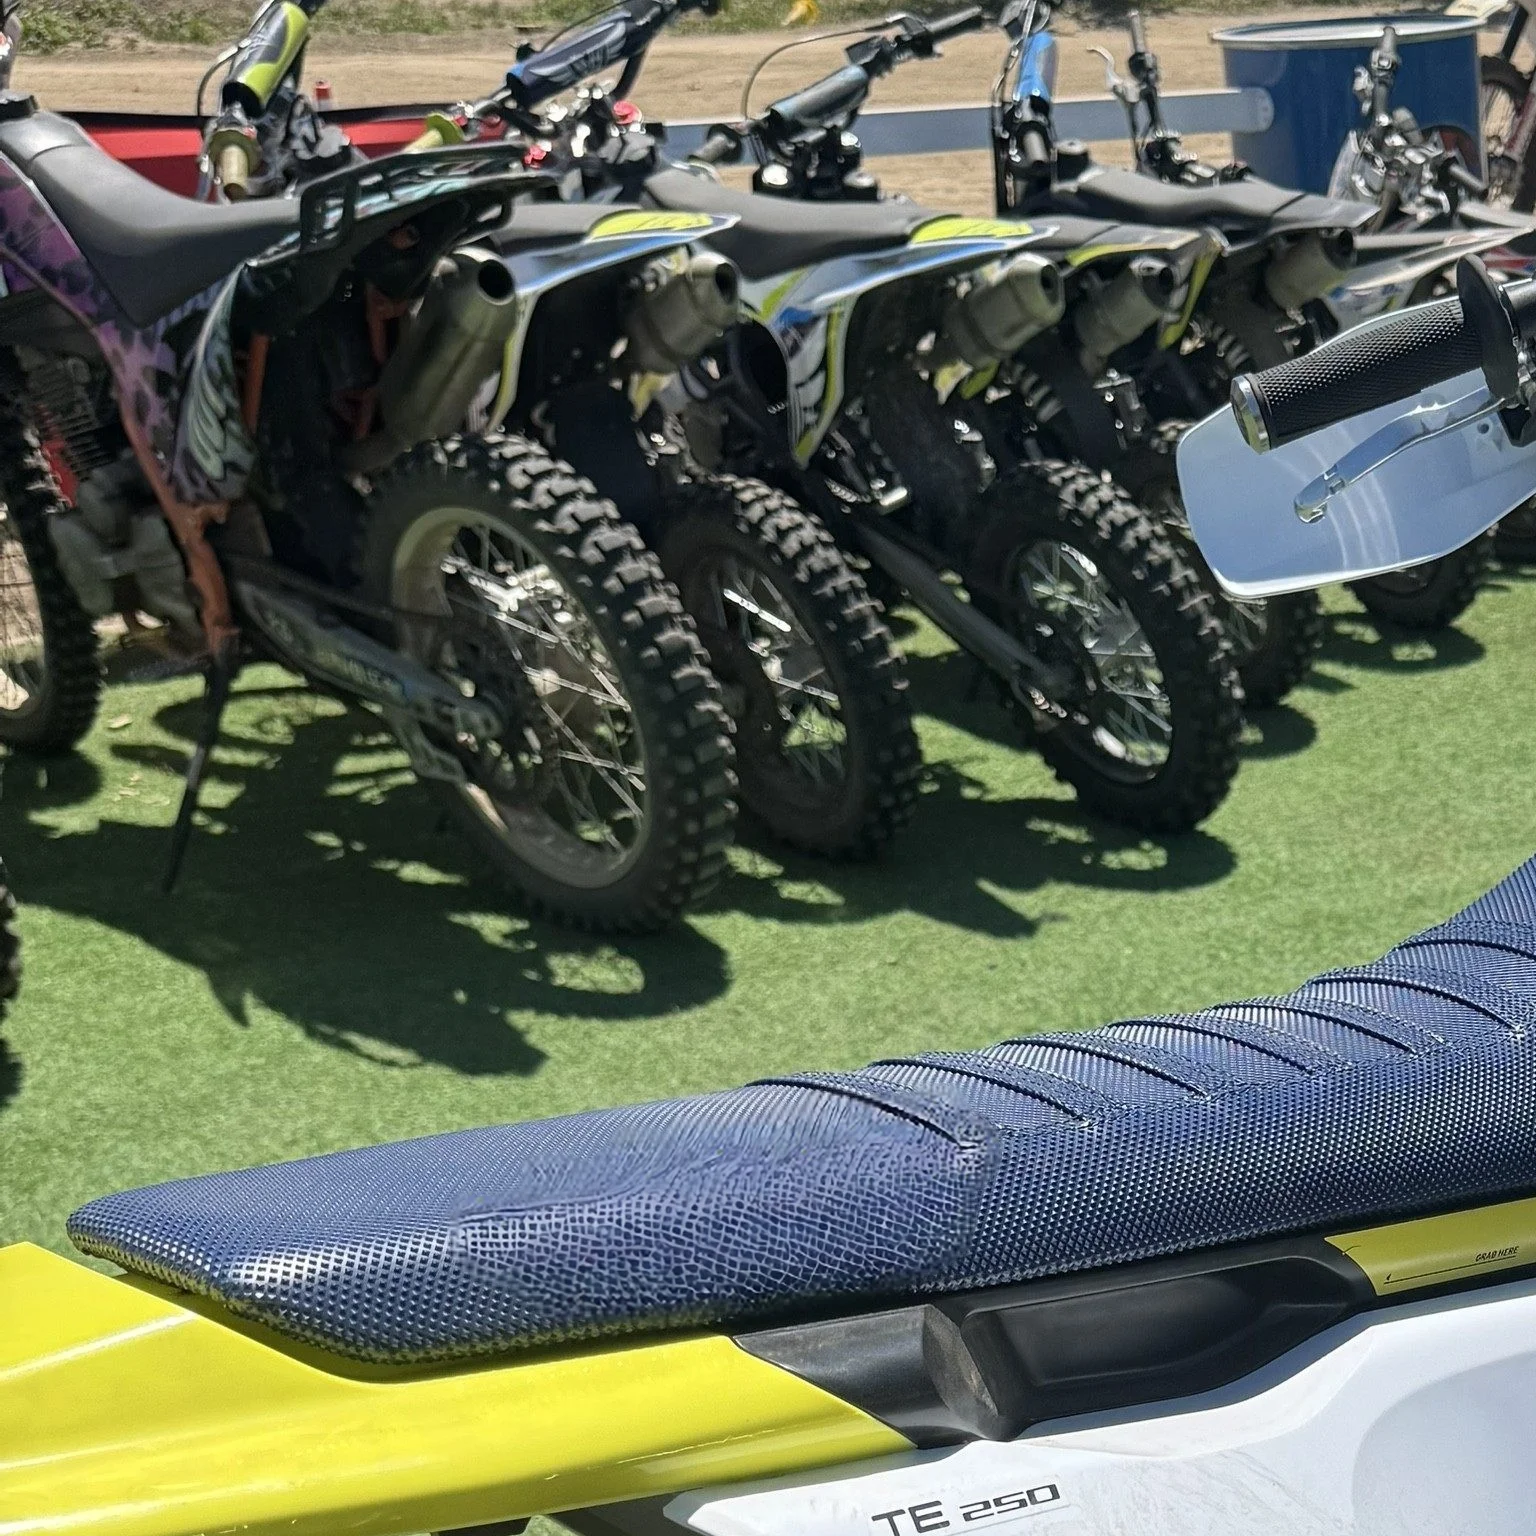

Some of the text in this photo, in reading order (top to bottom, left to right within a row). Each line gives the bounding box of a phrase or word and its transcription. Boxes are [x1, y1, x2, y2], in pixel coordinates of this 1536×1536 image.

[1475, 1245, 1520, 1262] GRAB HERE
[959, 1483, 1061, 1522] 250
